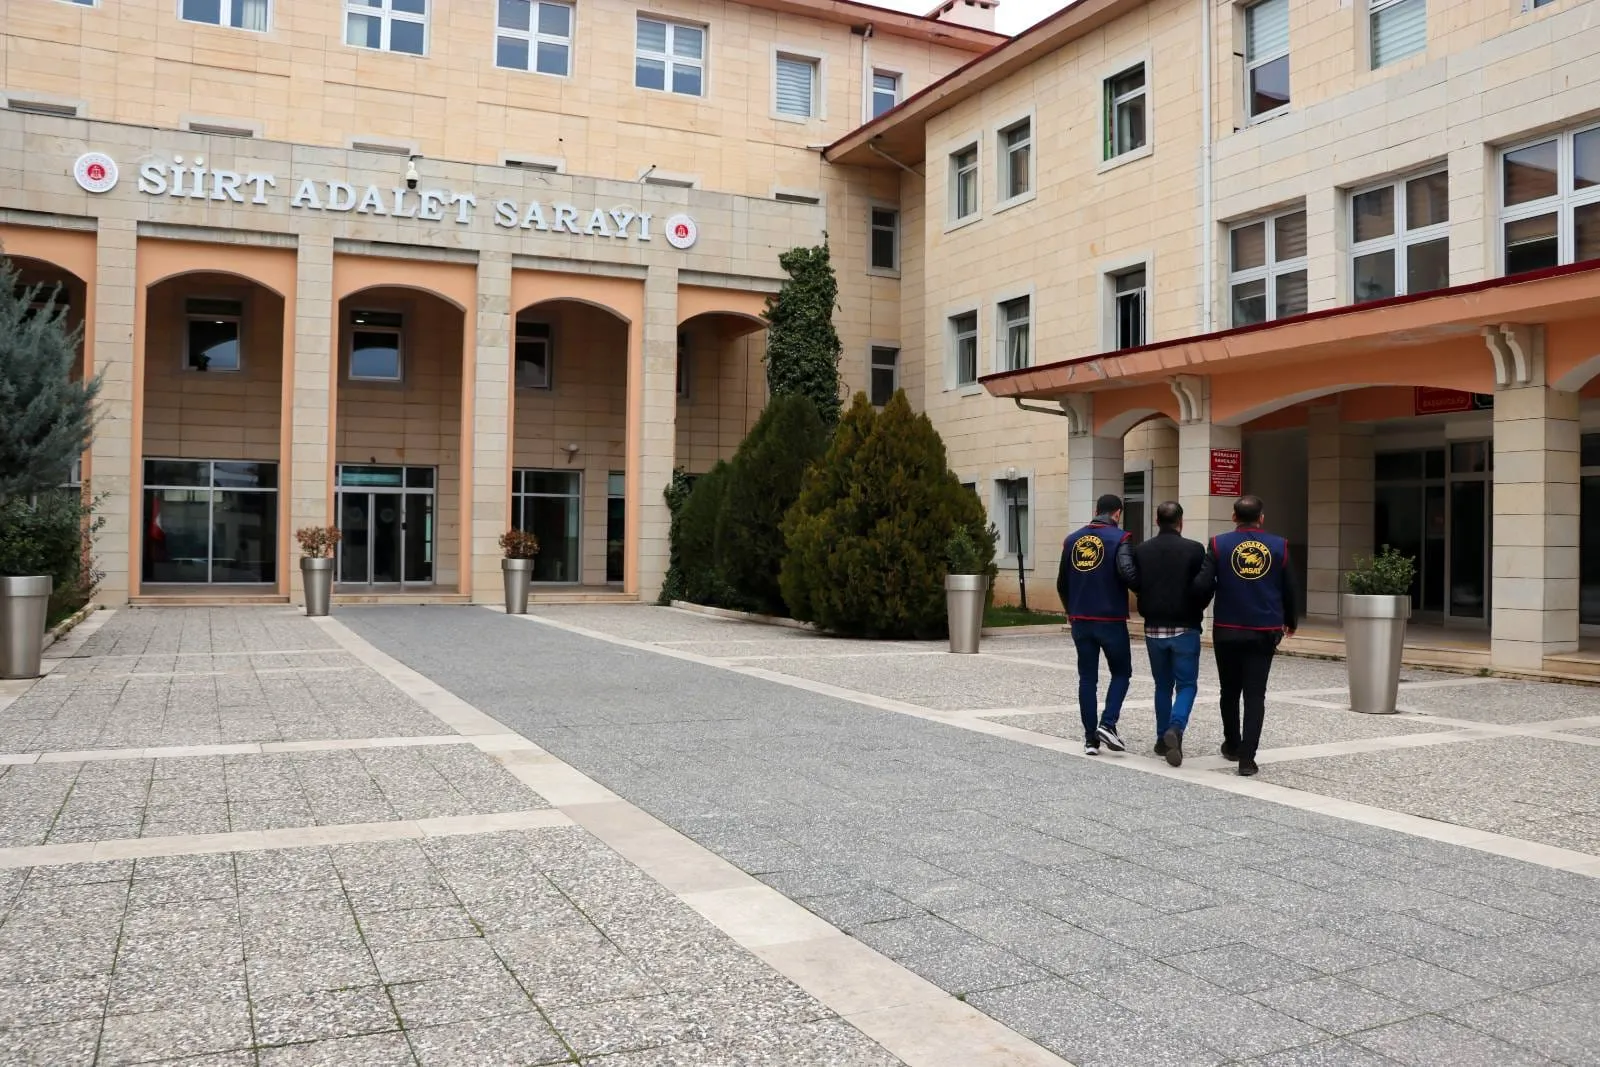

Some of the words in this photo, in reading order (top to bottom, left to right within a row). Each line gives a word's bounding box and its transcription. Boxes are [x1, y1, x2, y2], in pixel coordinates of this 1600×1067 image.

[138, 155, 276, 204] SİİRT
[291, 177, 477, 225] ADALET
[494, 198, 651, 241] SARAYI
[1236, 541, 1268, 555] JANDARMA
[1240, 567, 1261, 575] JASAT
